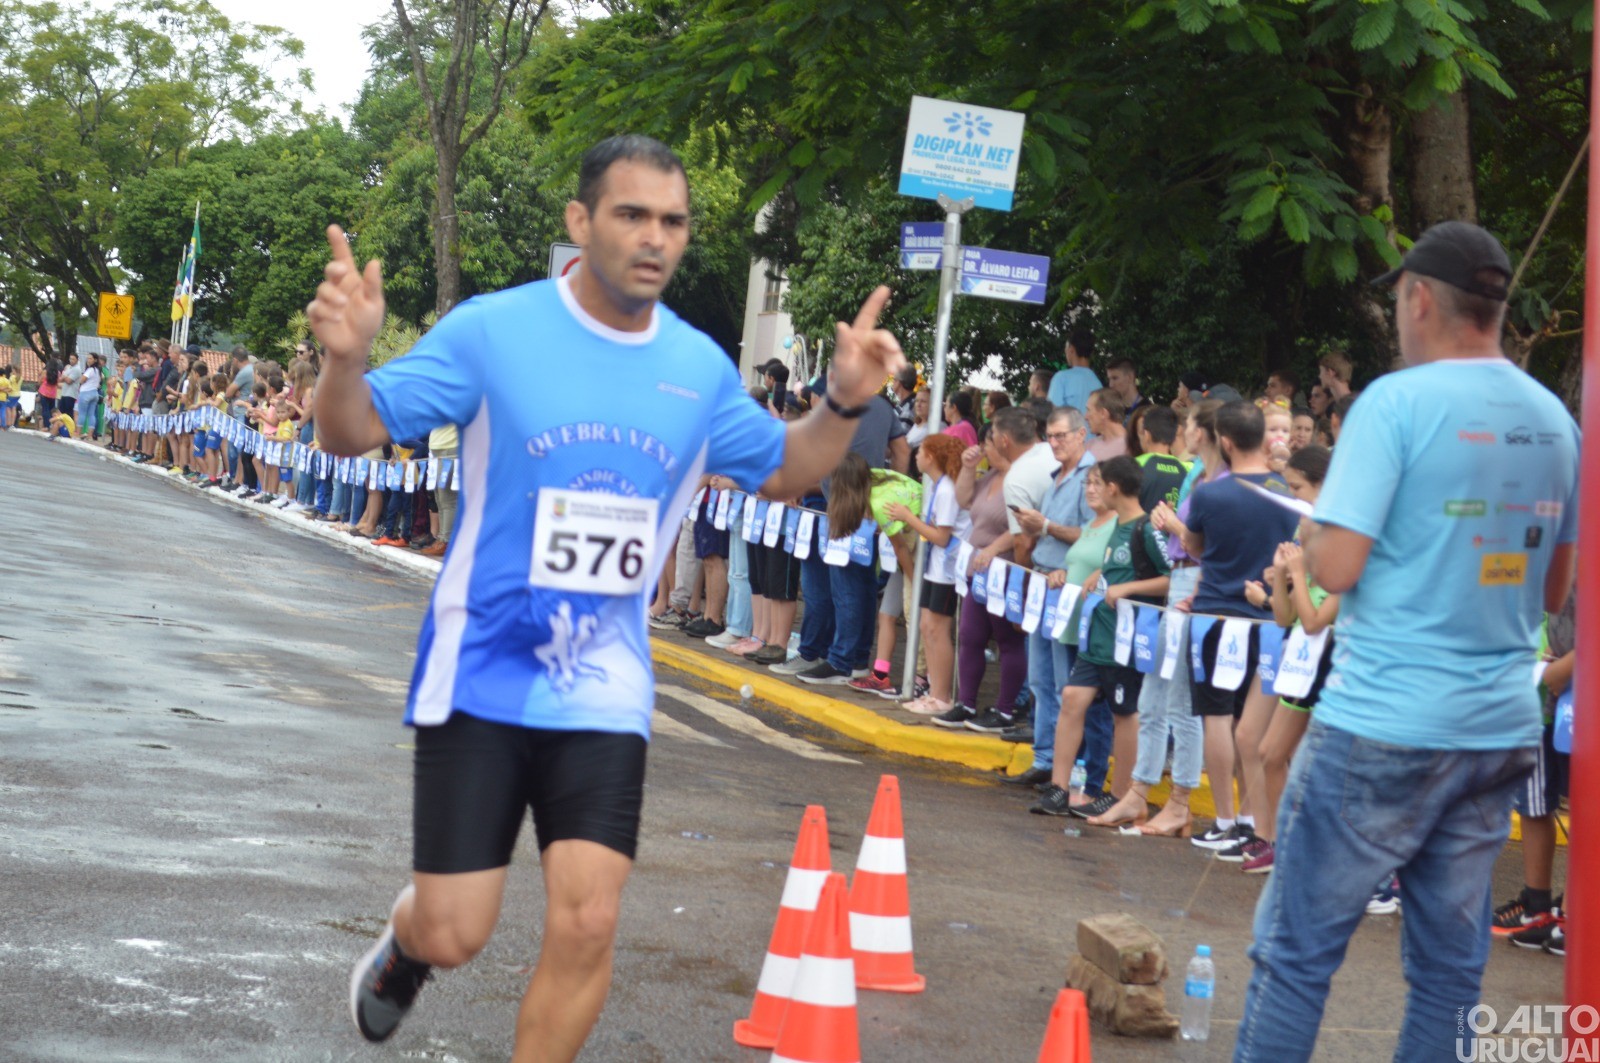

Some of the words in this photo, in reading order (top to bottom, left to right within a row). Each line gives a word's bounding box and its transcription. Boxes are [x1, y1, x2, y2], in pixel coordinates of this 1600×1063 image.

[913, 133, 983, 158] DIGIPLAN
[986, 146, 1014, 163] NET
[965, 250, 981, 259] RUA
[964, 260, 978, 273] DR.
[980, 260, 1010, 277] ÁLVARO
[1011, 266, 1040, 281] LEITÃO
[526, 421, 621, 458] QUEBRA
[628, 428, 680, 475] VENT
[544, 530, 644, 580] 576
[1282, 660, 1313, 677] Banrisul
